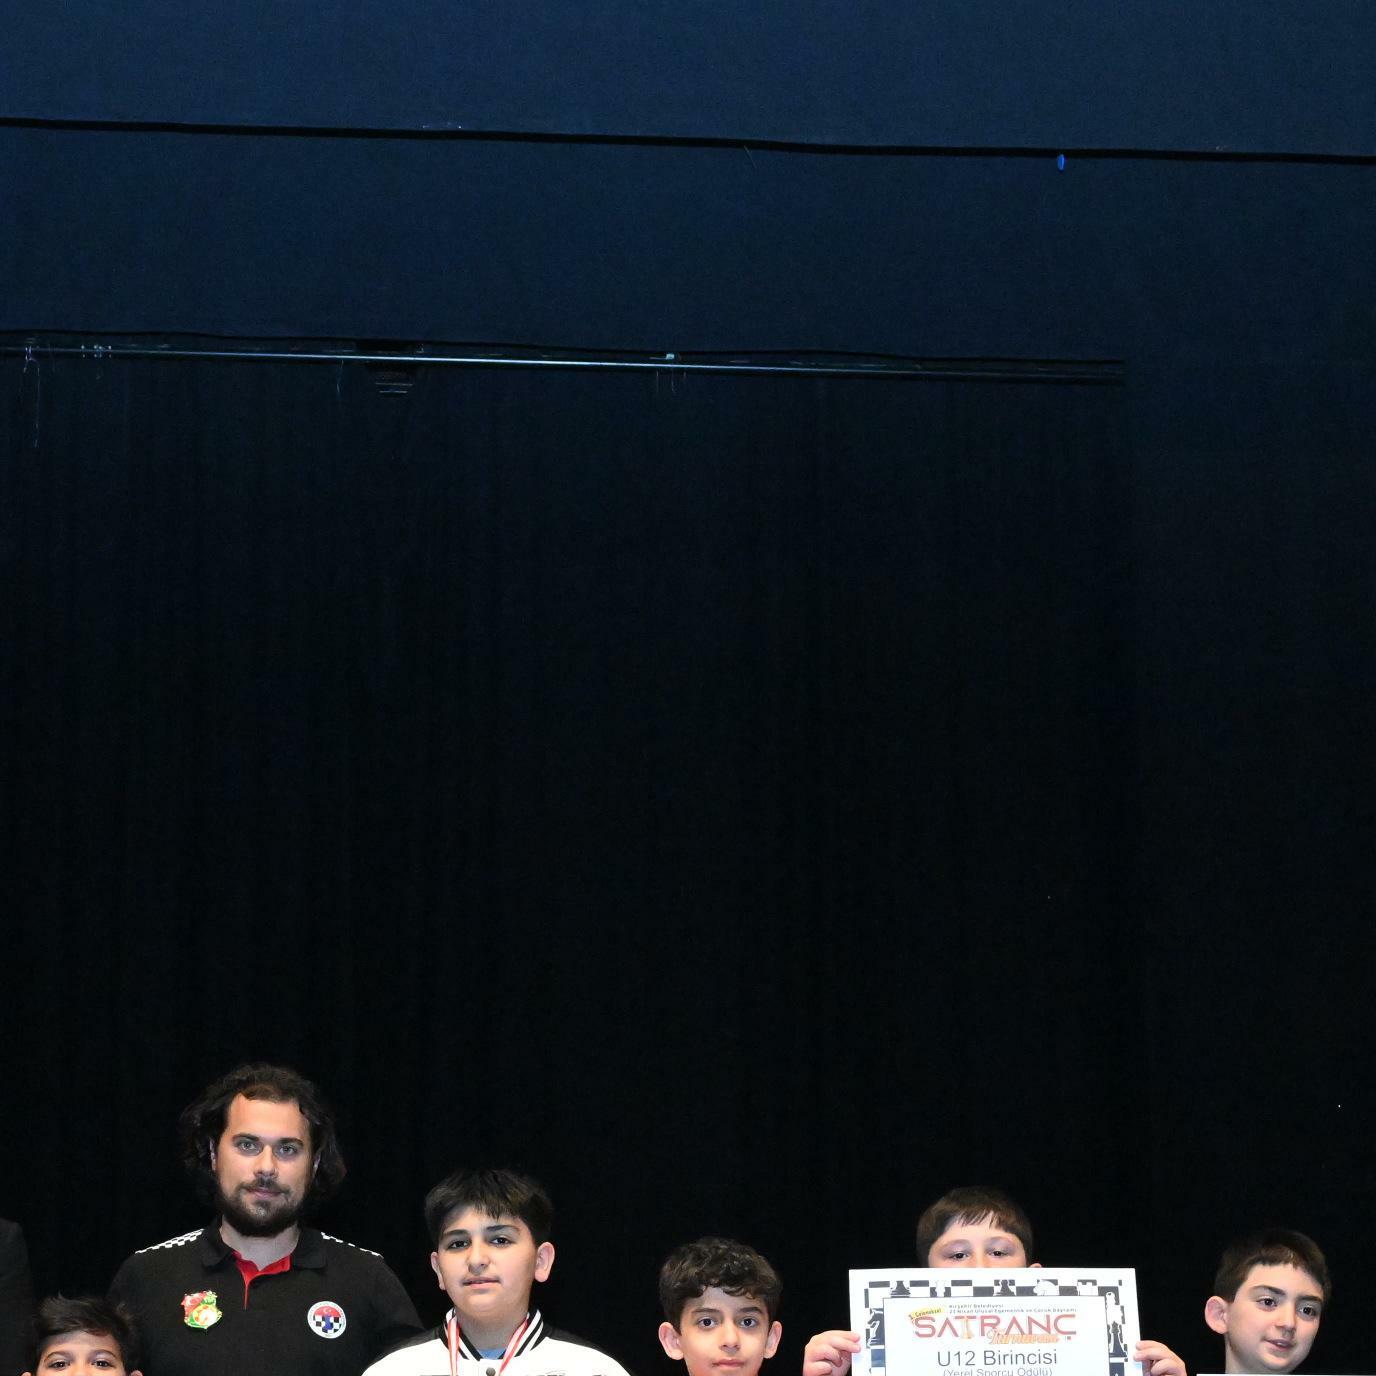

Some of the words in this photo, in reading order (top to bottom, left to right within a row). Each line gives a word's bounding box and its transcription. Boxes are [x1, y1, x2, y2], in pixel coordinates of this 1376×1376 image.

[913, 1313, 1077, 1342] SATRANÇ
[937, 1350, 976, 1367] U12
[983, 1348, 1057, 1366] Birincisi
